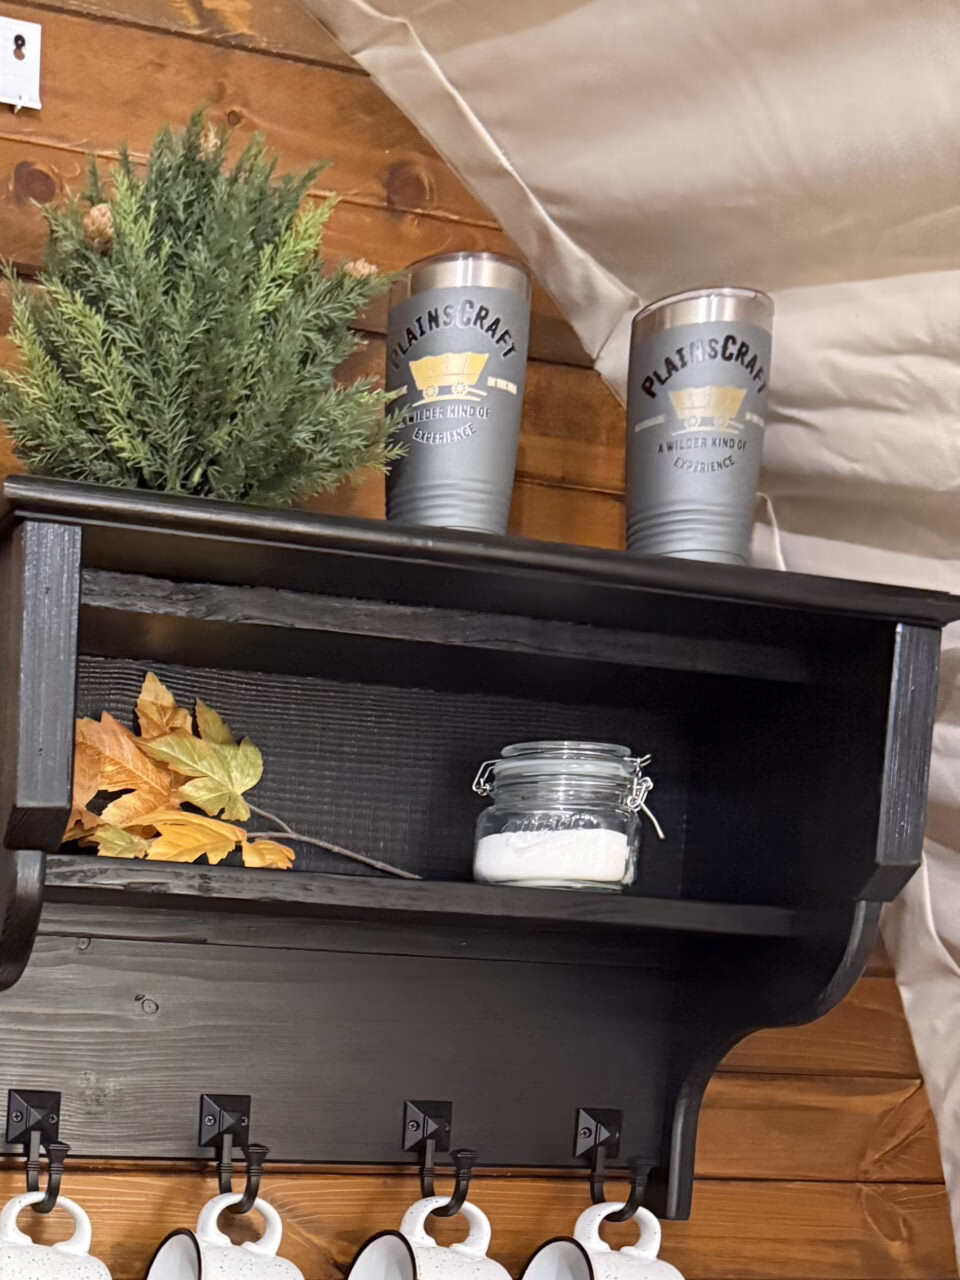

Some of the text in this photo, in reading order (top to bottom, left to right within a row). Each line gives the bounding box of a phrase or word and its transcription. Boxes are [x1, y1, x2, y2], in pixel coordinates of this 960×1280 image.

[392, 300, 517, 370] PLAINSCRAFT
[640, 334, 768, 399] PLAINSCRAFT
[666, 437, 708, 452] WILDER
[711, 437, 736, 449] KIND
[673, 454, 736, 473] EXPERIENCE
